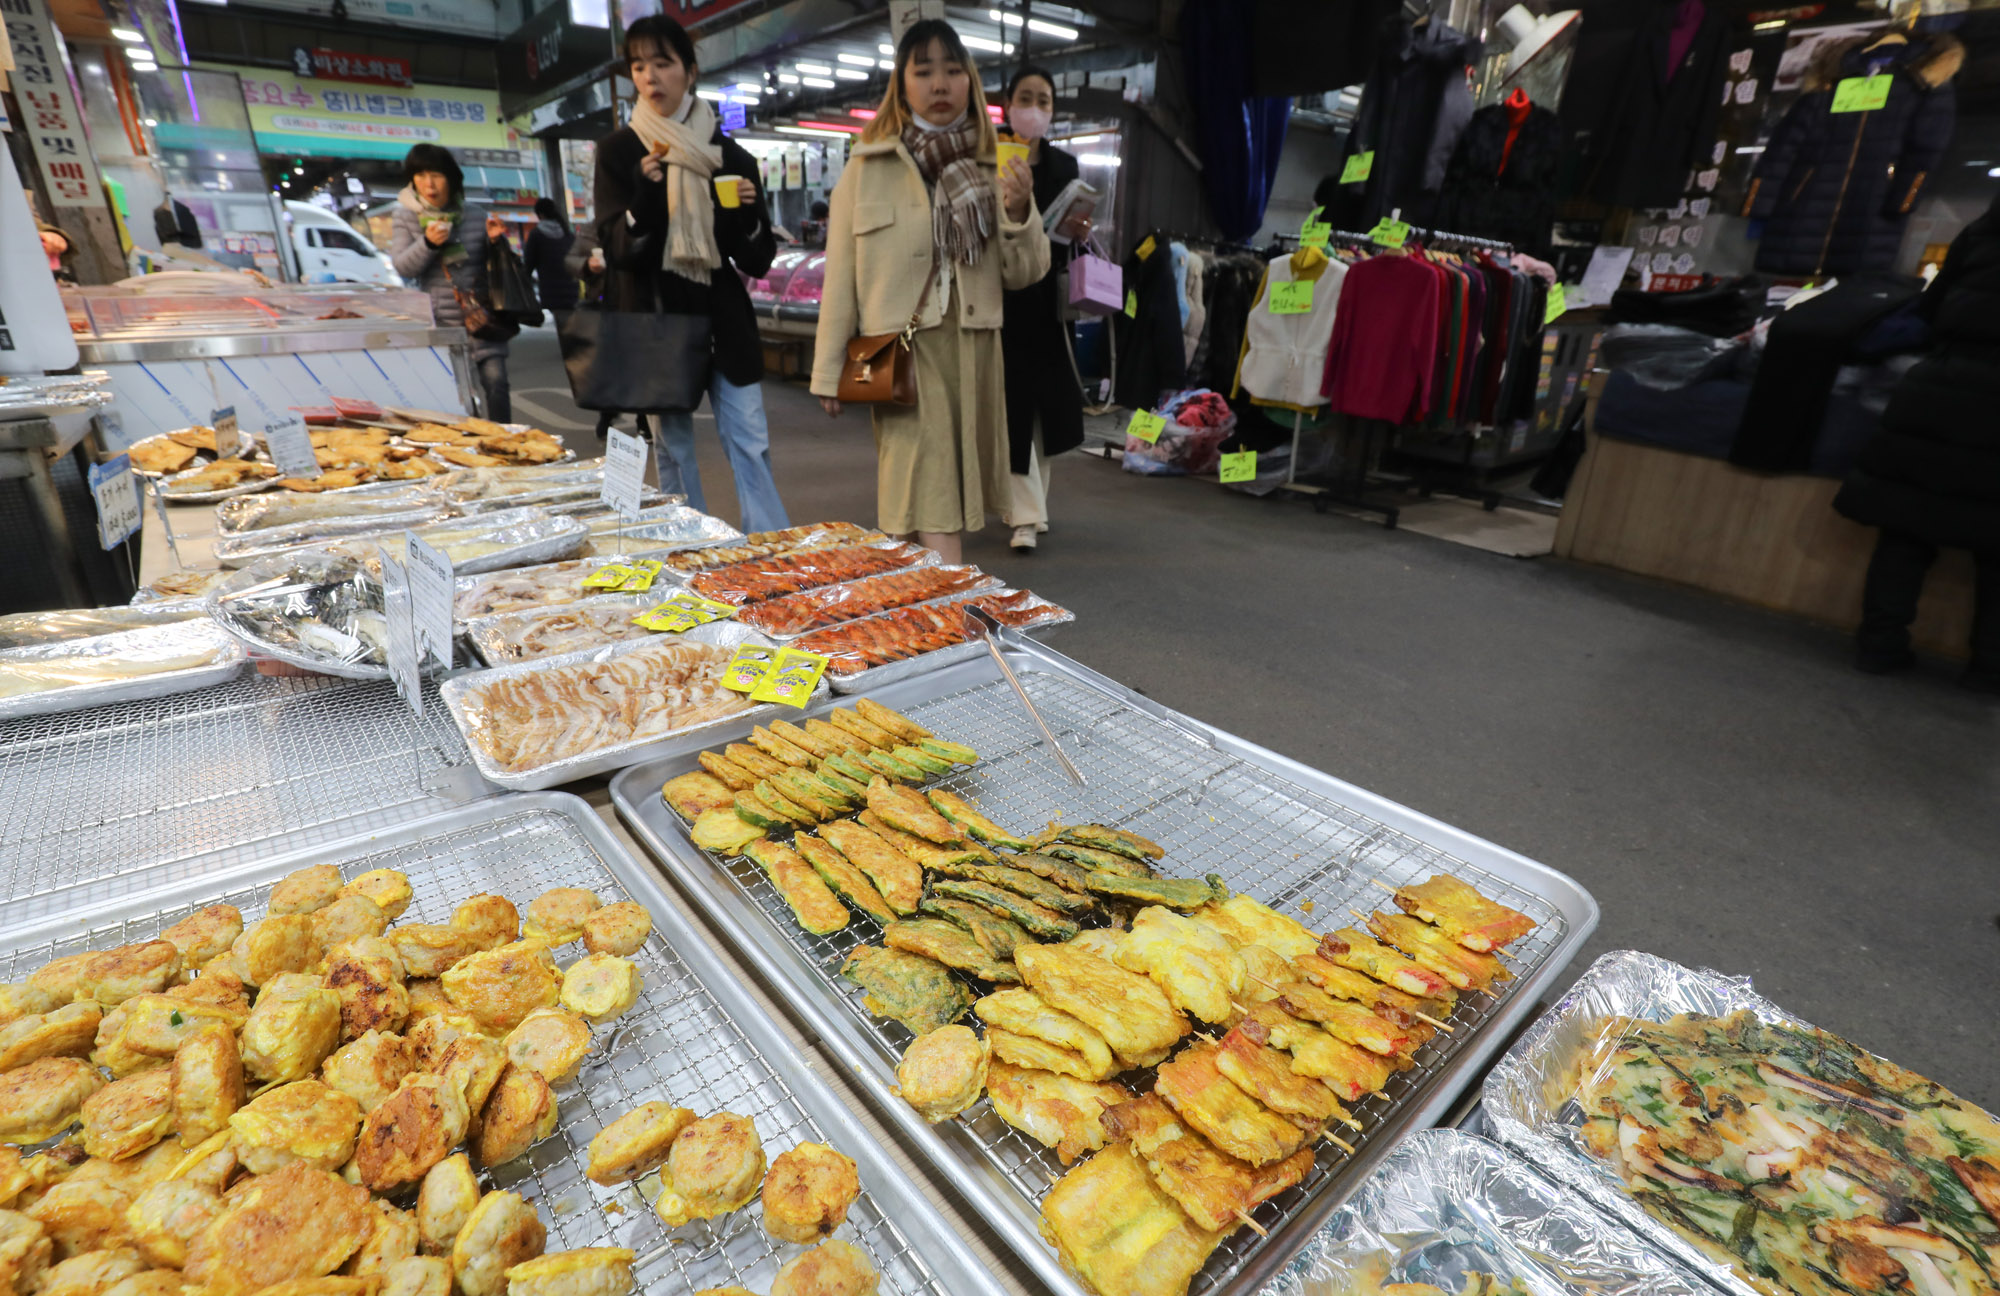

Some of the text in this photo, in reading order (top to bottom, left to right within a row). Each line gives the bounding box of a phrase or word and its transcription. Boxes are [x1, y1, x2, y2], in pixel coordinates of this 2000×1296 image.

[314, 54, 403, 80] 비상소화전
[25, 90, 68, 130] 납품
[41, 136, 77, 156] 및
[48, 162, 90, 199] 배달
